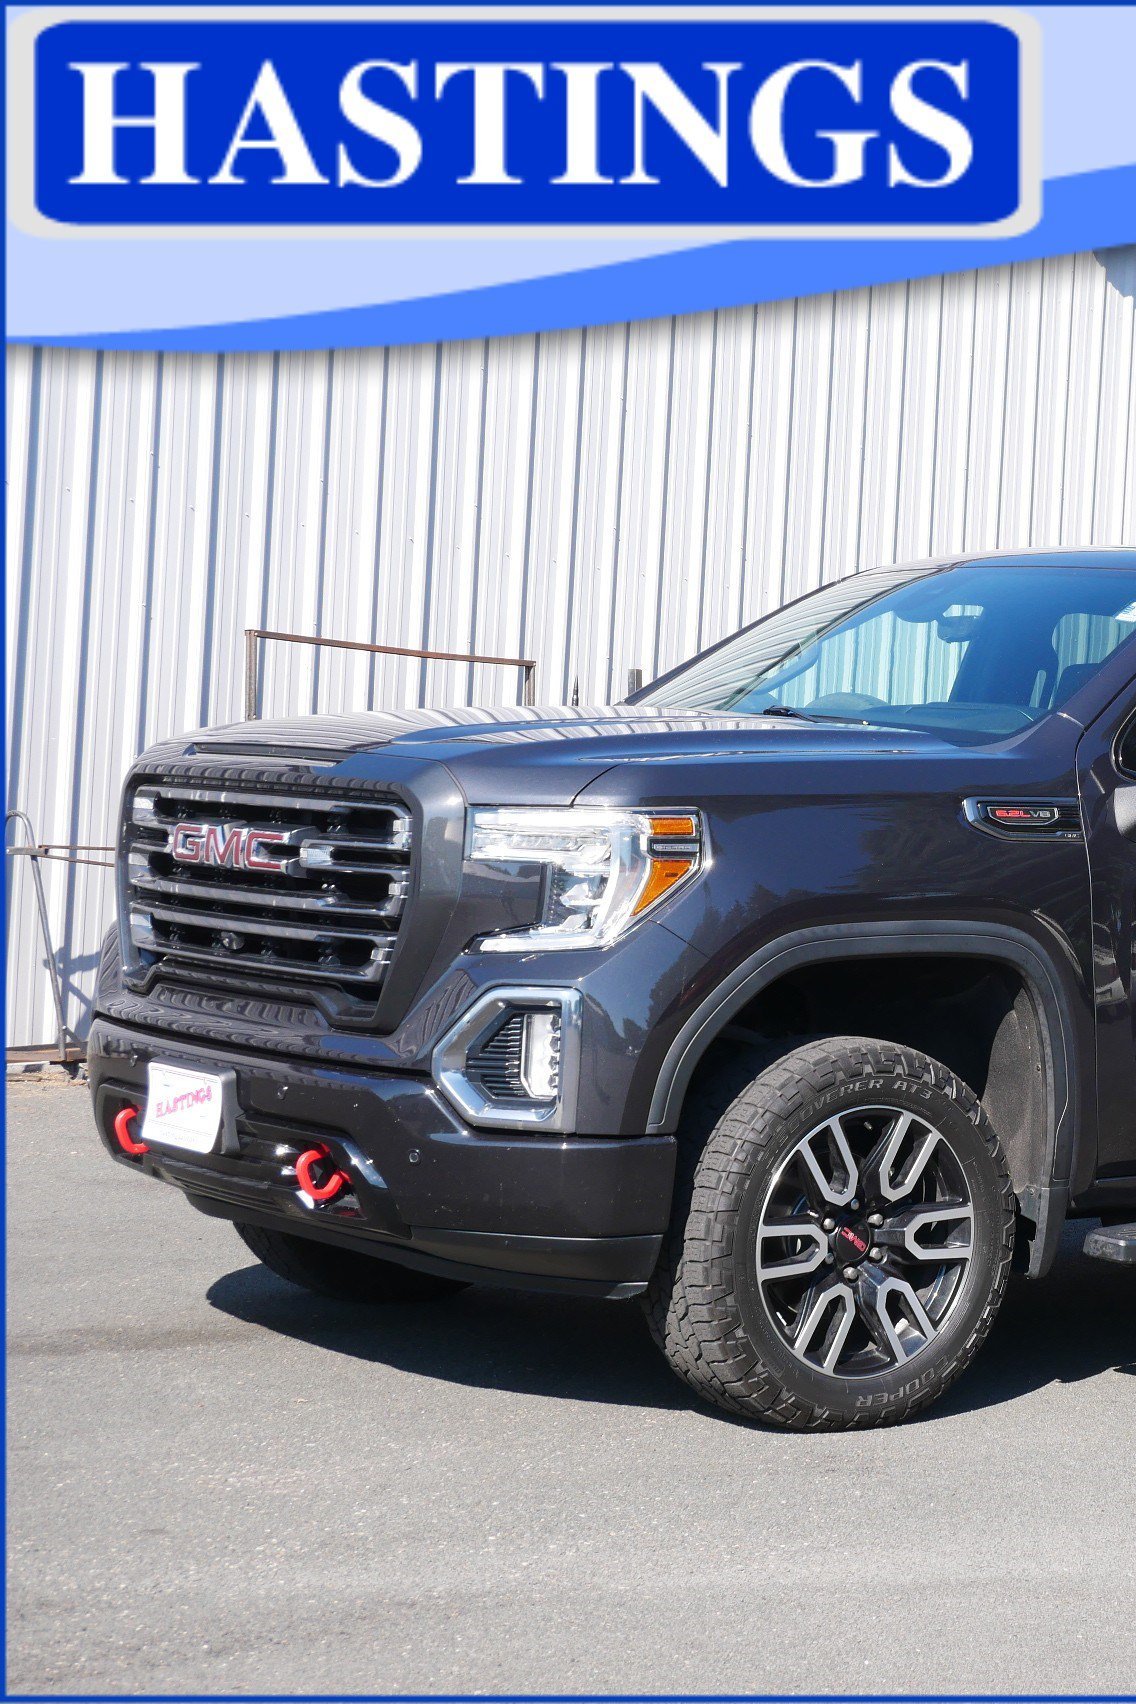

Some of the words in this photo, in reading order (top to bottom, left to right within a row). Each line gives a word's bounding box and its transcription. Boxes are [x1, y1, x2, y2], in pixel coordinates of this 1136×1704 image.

[173, 823, 290, 874] GMC
[891, 1080, 933, 1100] AT3
[855, 1355, 949, 1407] COOPER
